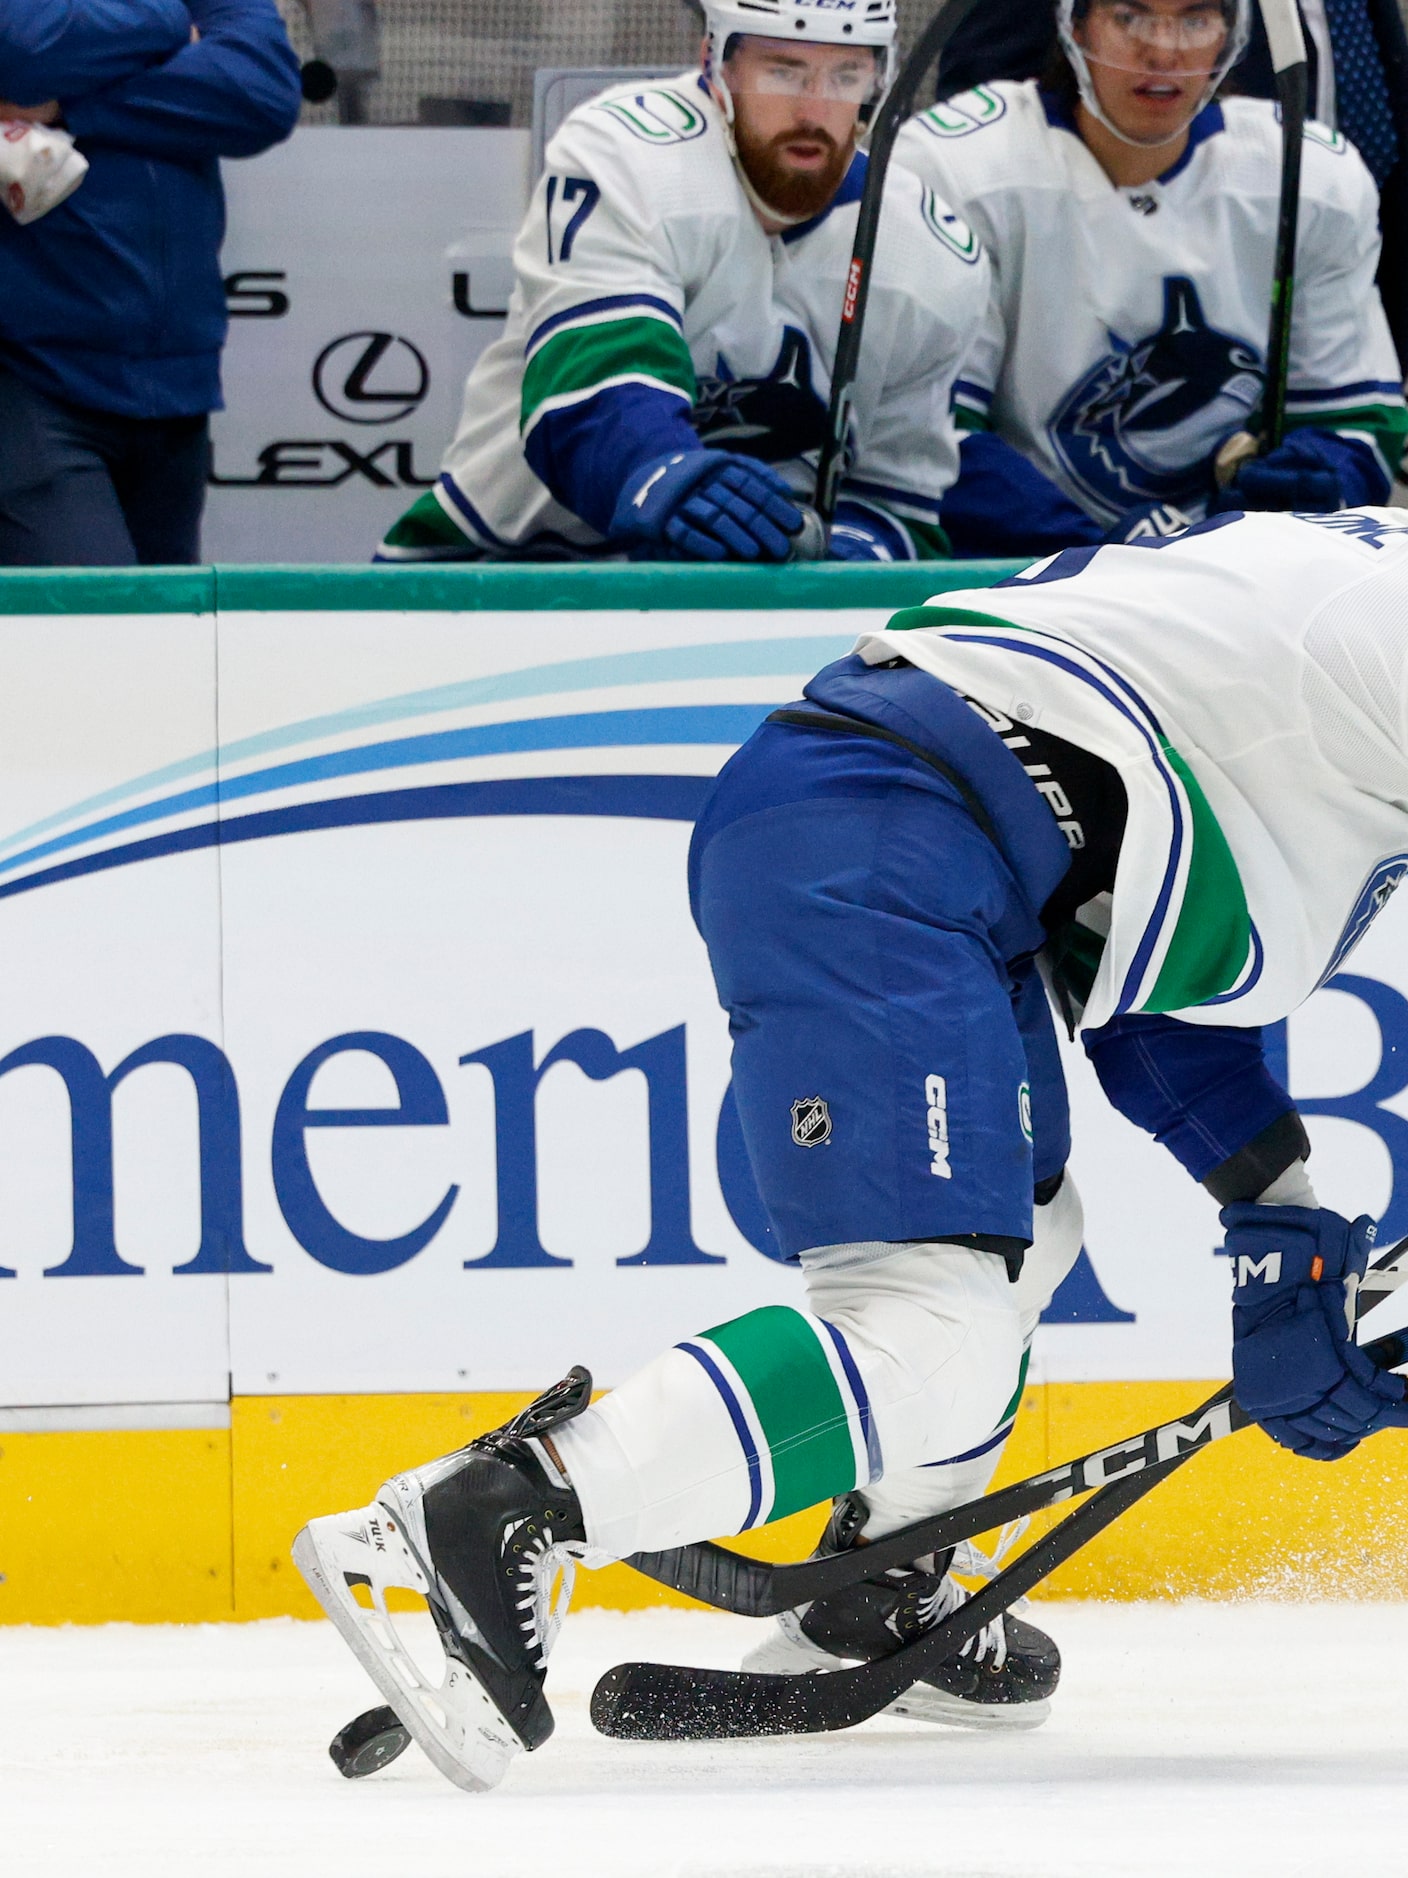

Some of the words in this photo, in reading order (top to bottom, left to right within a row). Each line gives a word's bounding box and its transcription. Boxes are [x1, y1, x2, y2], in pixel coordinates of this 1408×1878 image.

[546, 176, 601, 264] 17
[843, 264, 861, 319] CCM
[800, 1108, 824, 1138] NHL
[924, 1073, 952, 1180] CCM
